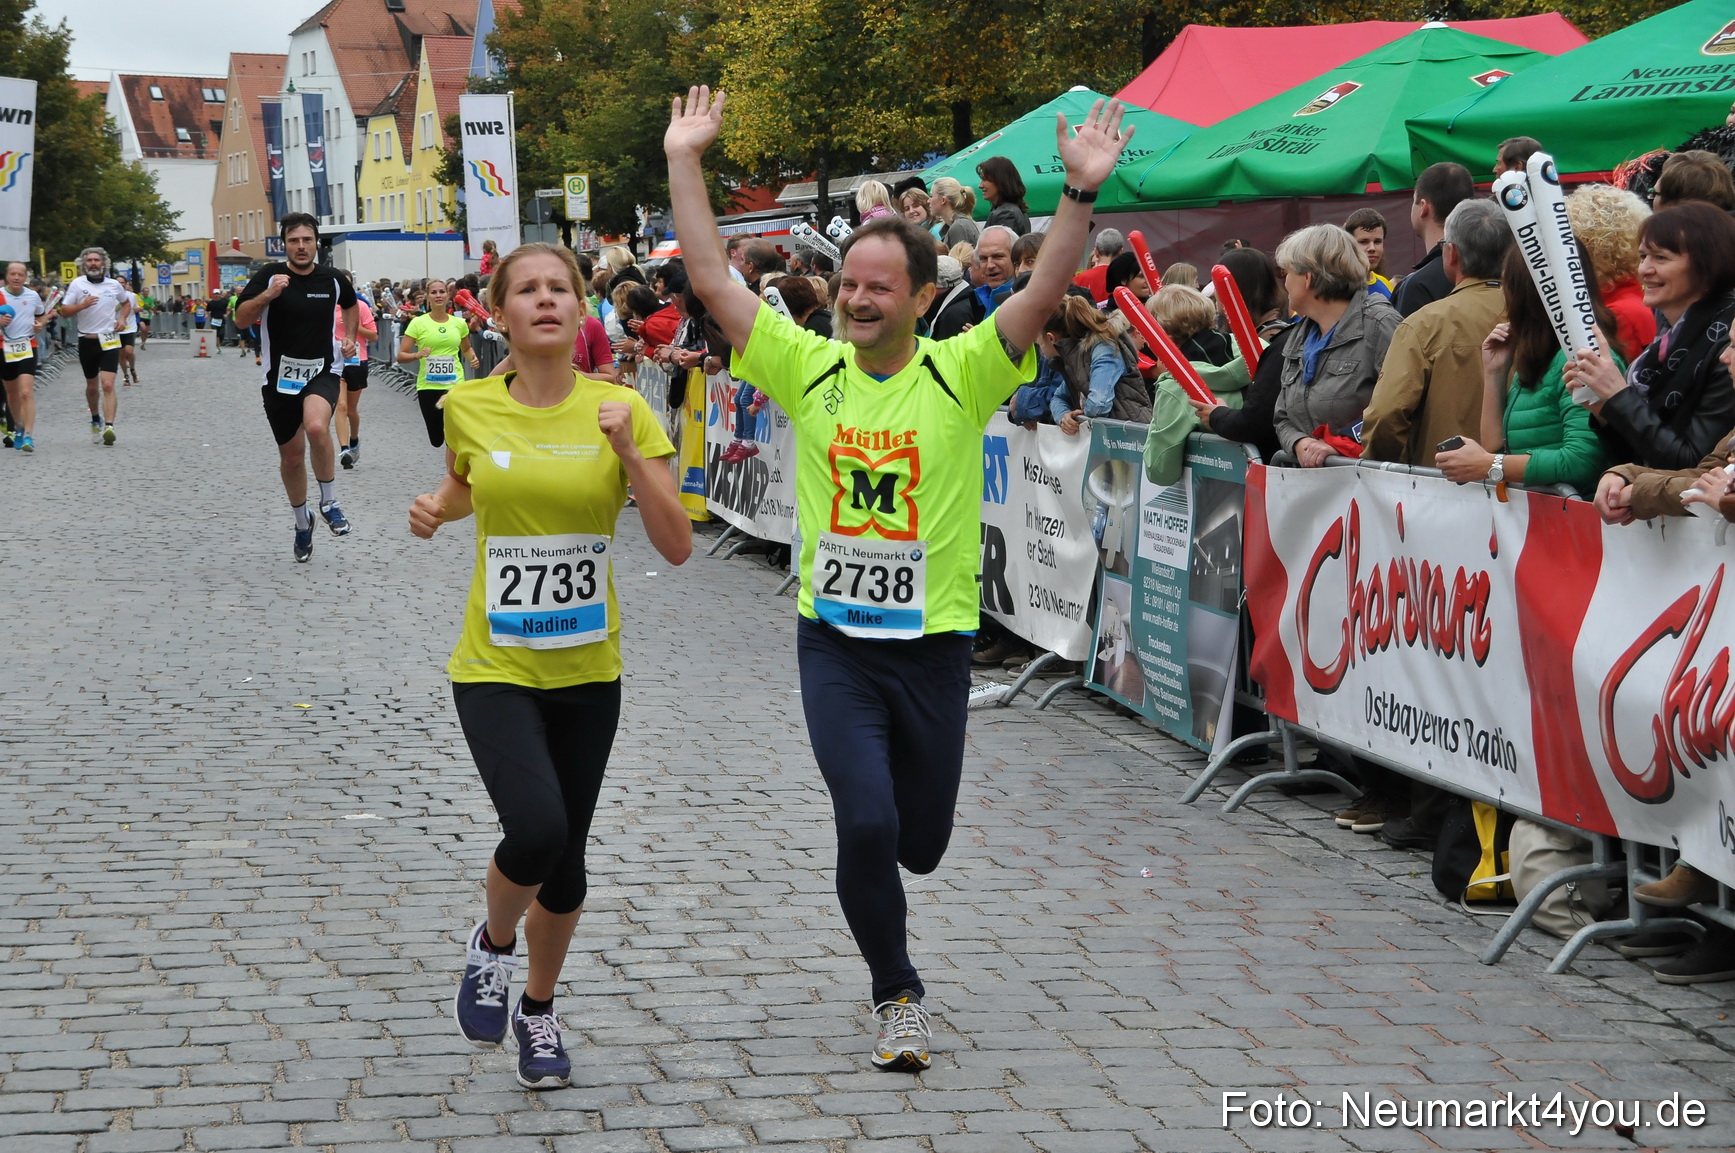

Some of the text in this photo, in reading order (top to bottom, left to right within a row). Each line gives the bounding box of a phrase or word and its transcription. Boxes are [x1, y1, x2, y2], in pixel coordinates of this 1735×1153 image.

[428, 362, 454, 374] 2550
[833, 423, 918, 450] Müller
[850, 470, 899, 514] M
[489, 544, 587, 558] PARTL Neumarkt
[819, 540, 906, 561] PARTL Neumarkt
[499, 559, 597, 607] 2733
[822, 558, 914, 604] 2738
[491, 603, 497, 612] A
[1295, 498, 1498, 695] Charivari
[522, 616, 578, 634] Nadine
[847, 609, 883, 625] Mike
[1364, 685, 1517, 775] Ostbayerns Radio
